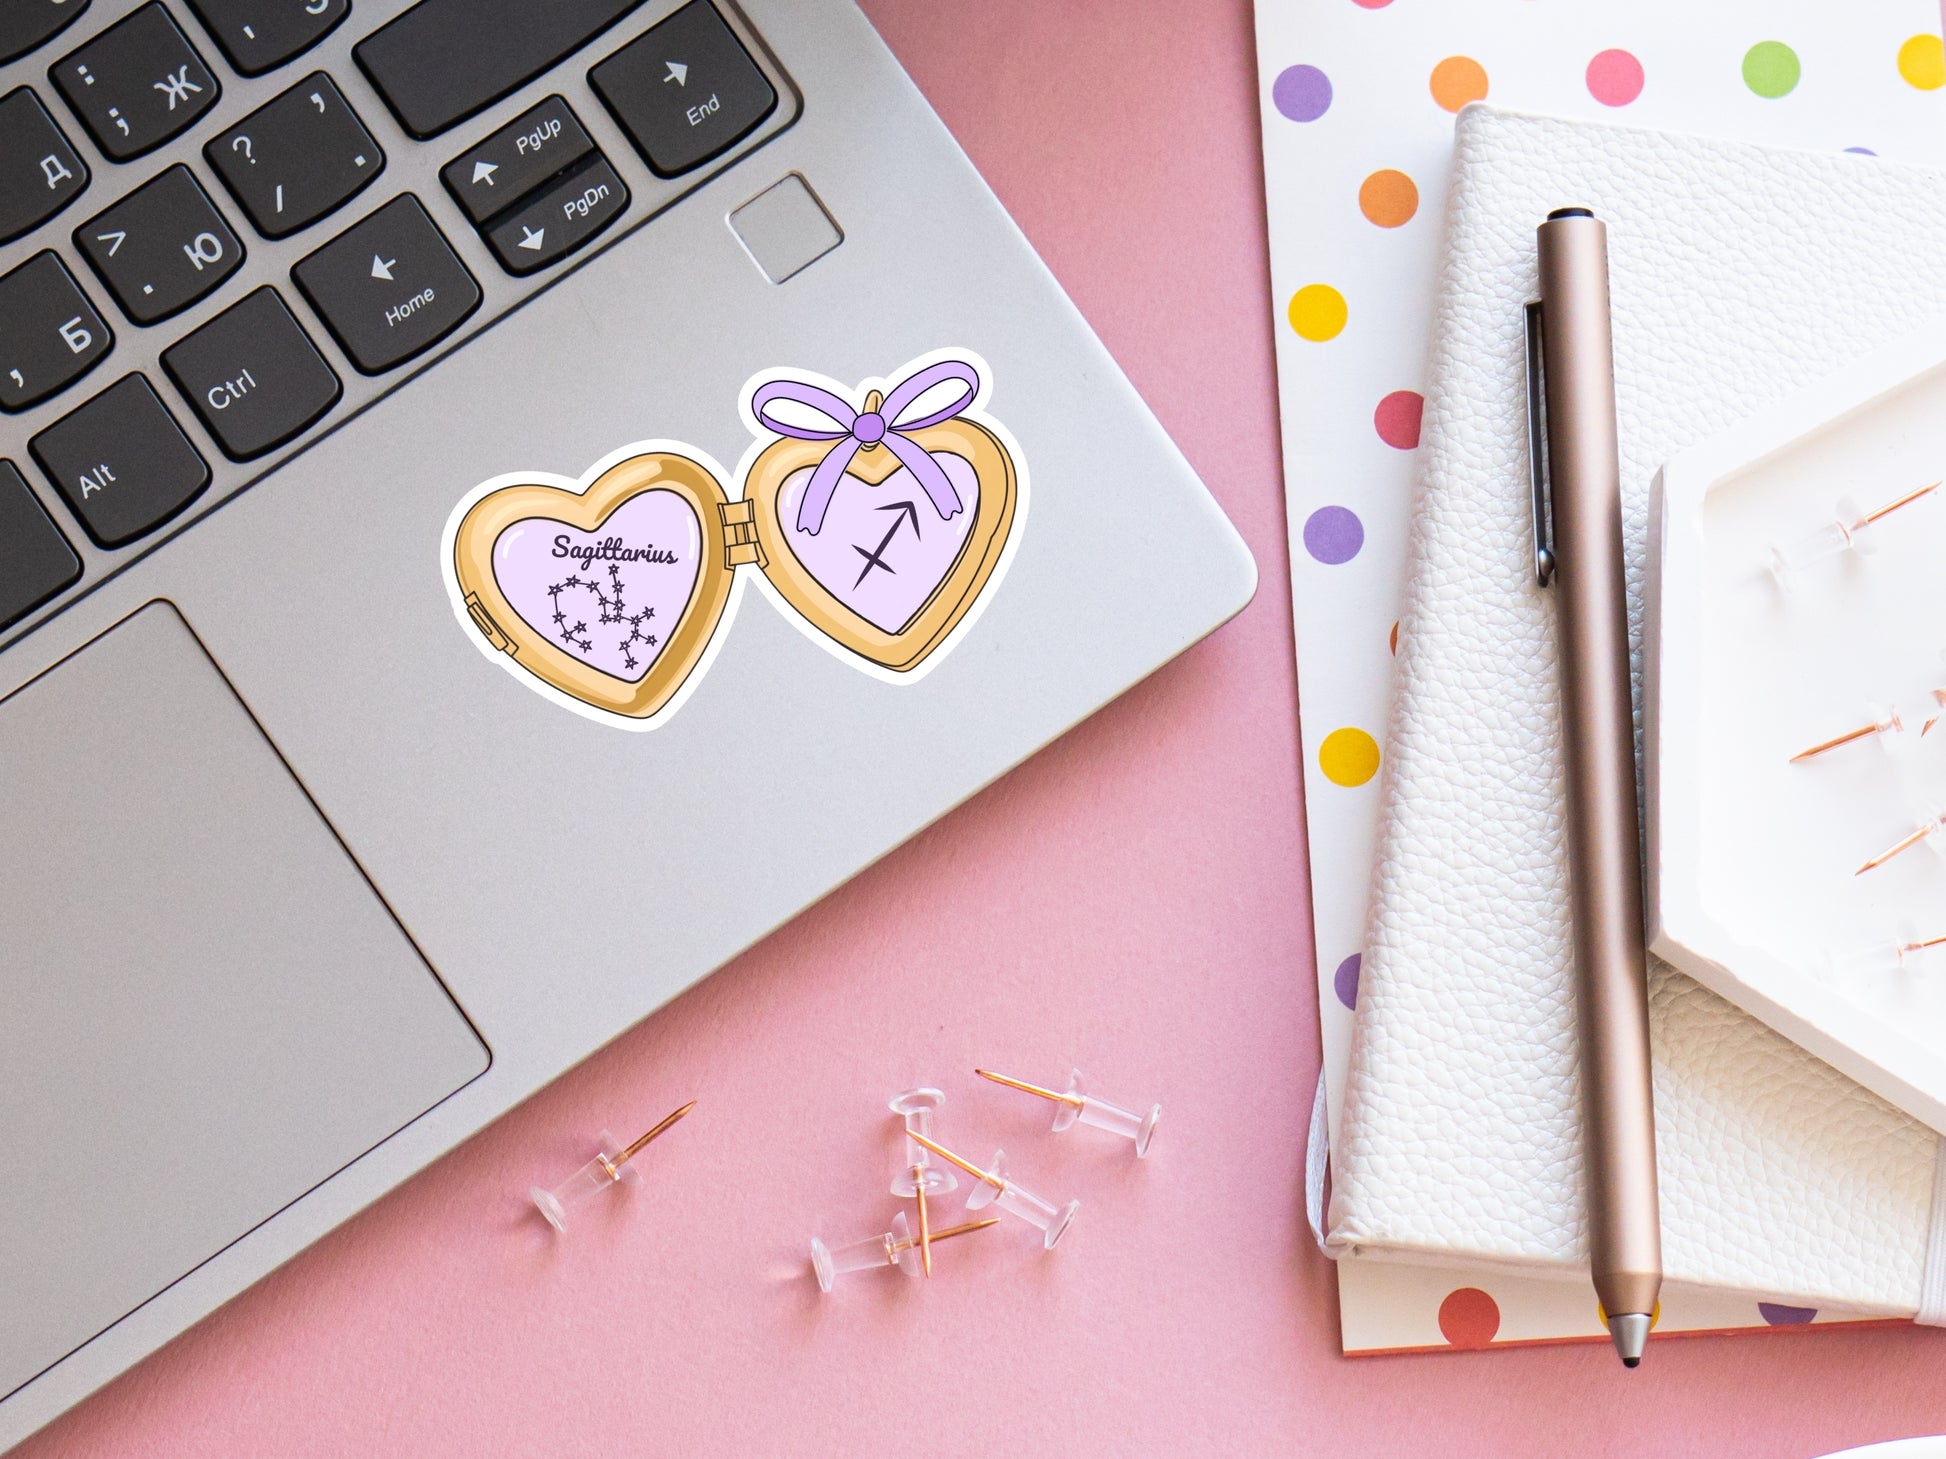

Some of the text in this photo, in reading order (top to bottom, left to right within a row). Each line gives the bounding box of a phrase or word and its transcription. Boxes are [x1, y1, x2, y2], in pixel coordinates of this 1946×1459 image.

[153, 64, 203, 111] Ж
[686, 93, 721, 126] End
[232, 136, 256, 165] ?
[515, 117, 562, 155] PgUp
[40, 154, 73, 190] Д
[563, 183, 610, 221] PgDn
[183, 232, 223, 271] Ю
[385, 286, 435, 327] Home
[58, 316, 92, 354] Б
[207, 368, 257, 410] Ctrl
[79, 463, 117, 500] Alt
[551, 534, 679, 571] Sagittarius
